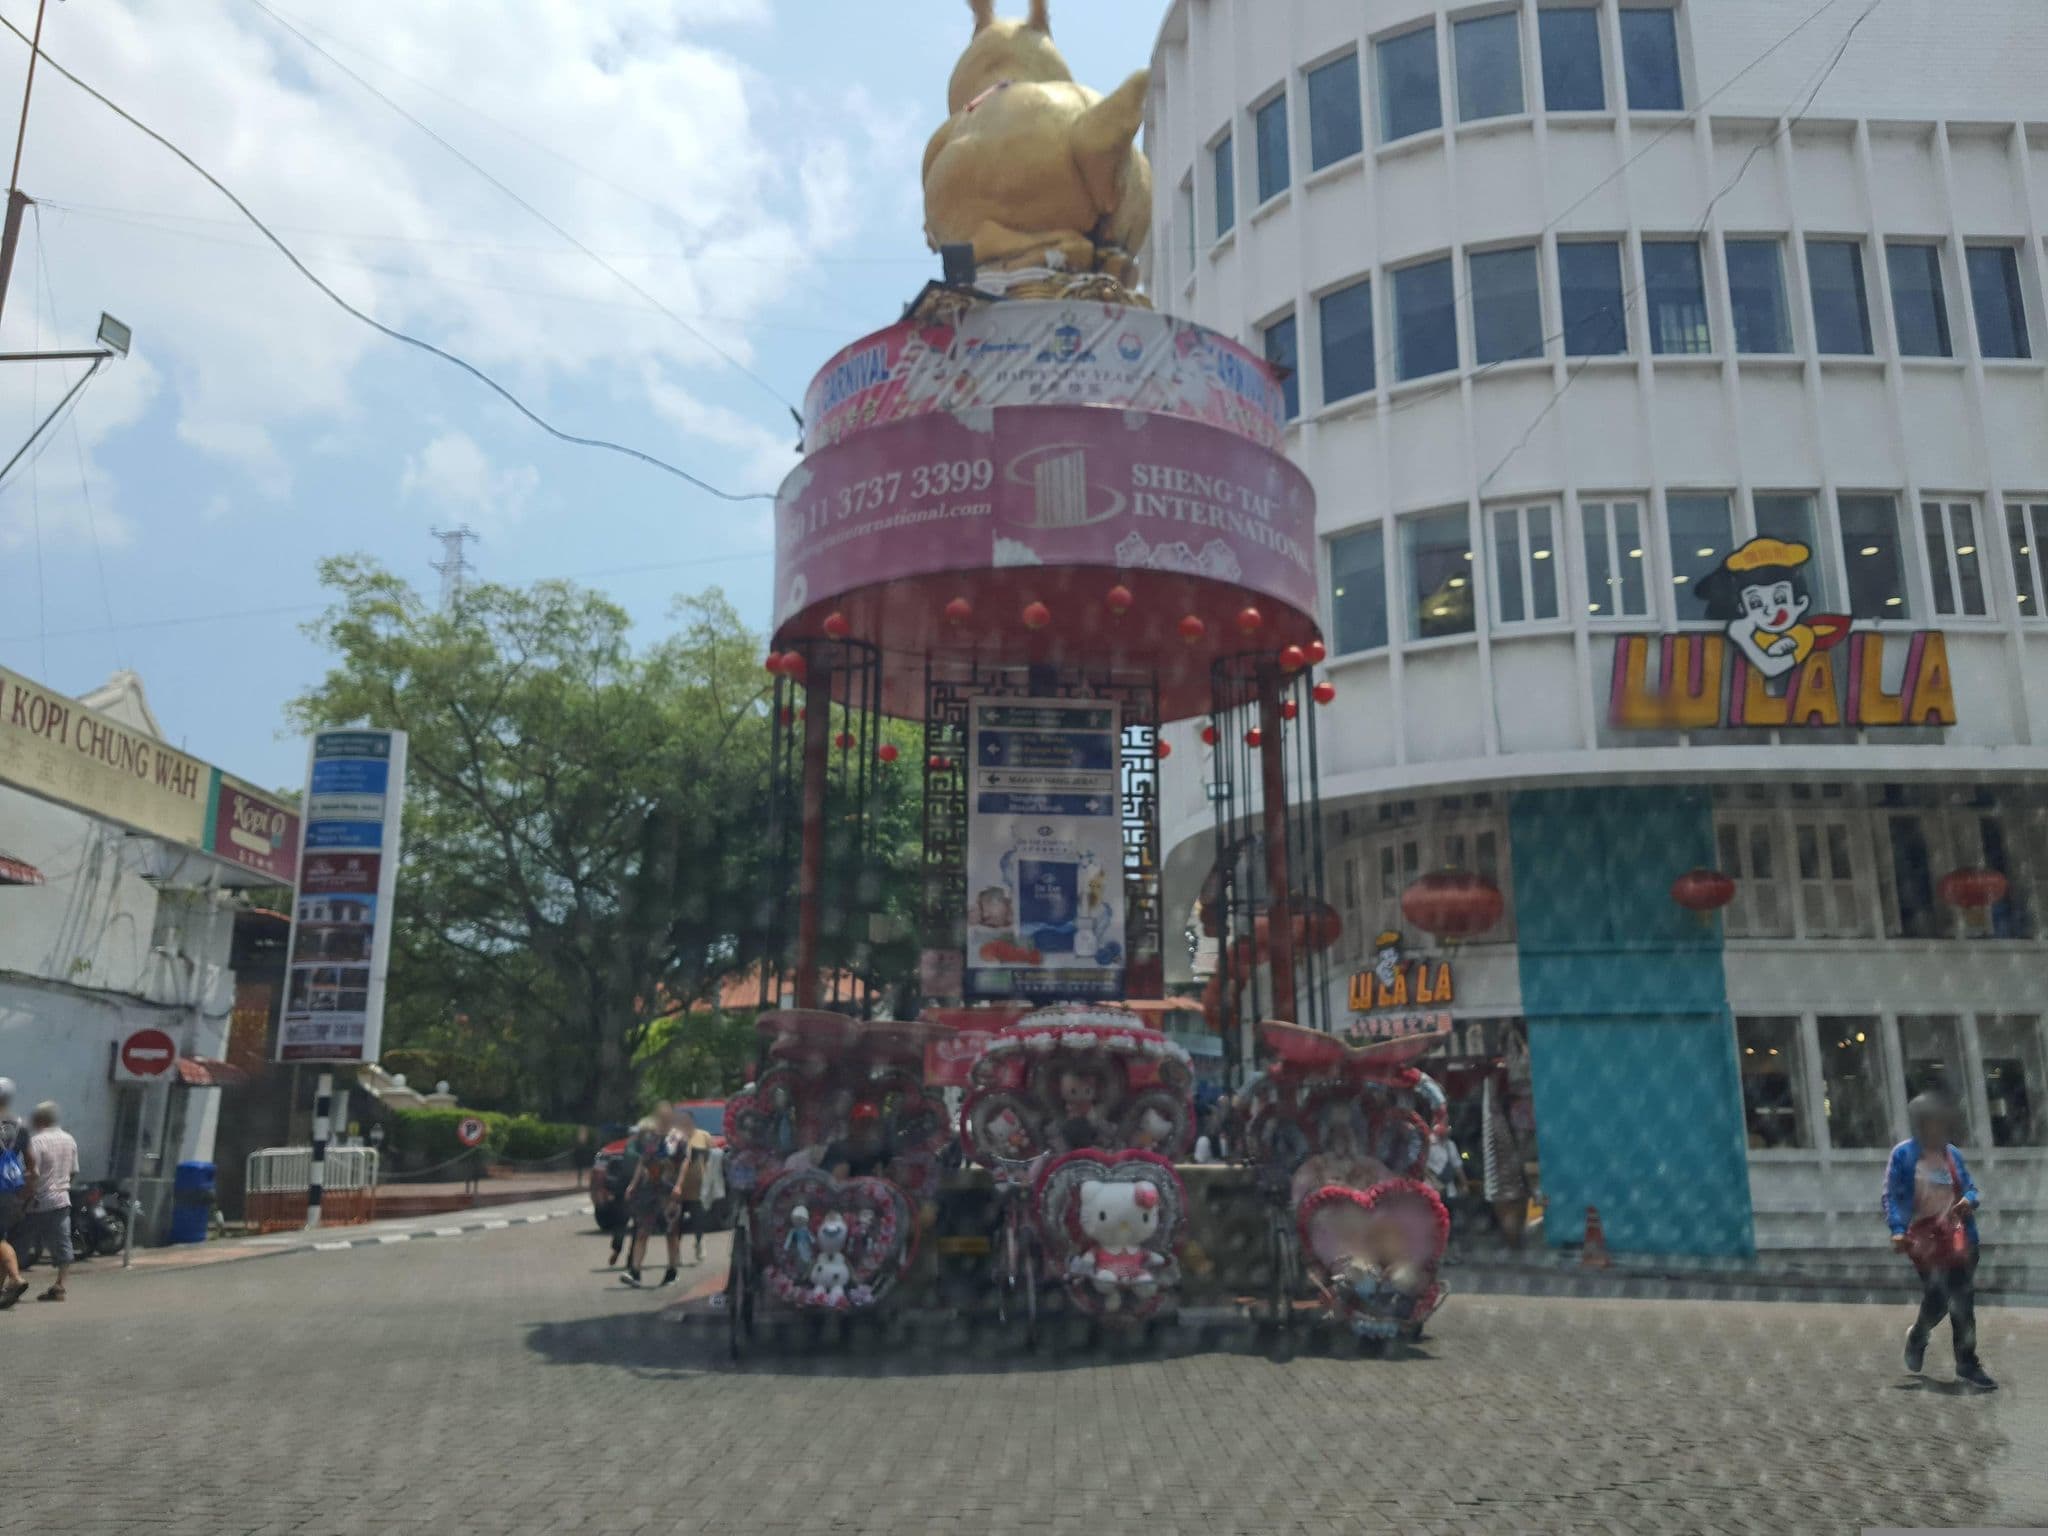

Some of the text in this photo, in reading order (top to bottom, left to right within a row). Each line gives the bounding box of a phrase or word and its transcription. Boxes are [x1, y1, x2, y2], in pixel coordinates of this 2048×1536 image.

[836, 471, 902, 520] 3737
[910, 458, 994, 499] 3399
[1131, 463, 1272, 521] SHENG TAI
[1133, 492, 1312, 577] INTERNATIONAL
[11, 685, 70, 744] KOPI
[76, 715, 150, 779] CHUNG
[155, 750, 200, 800] WAH
